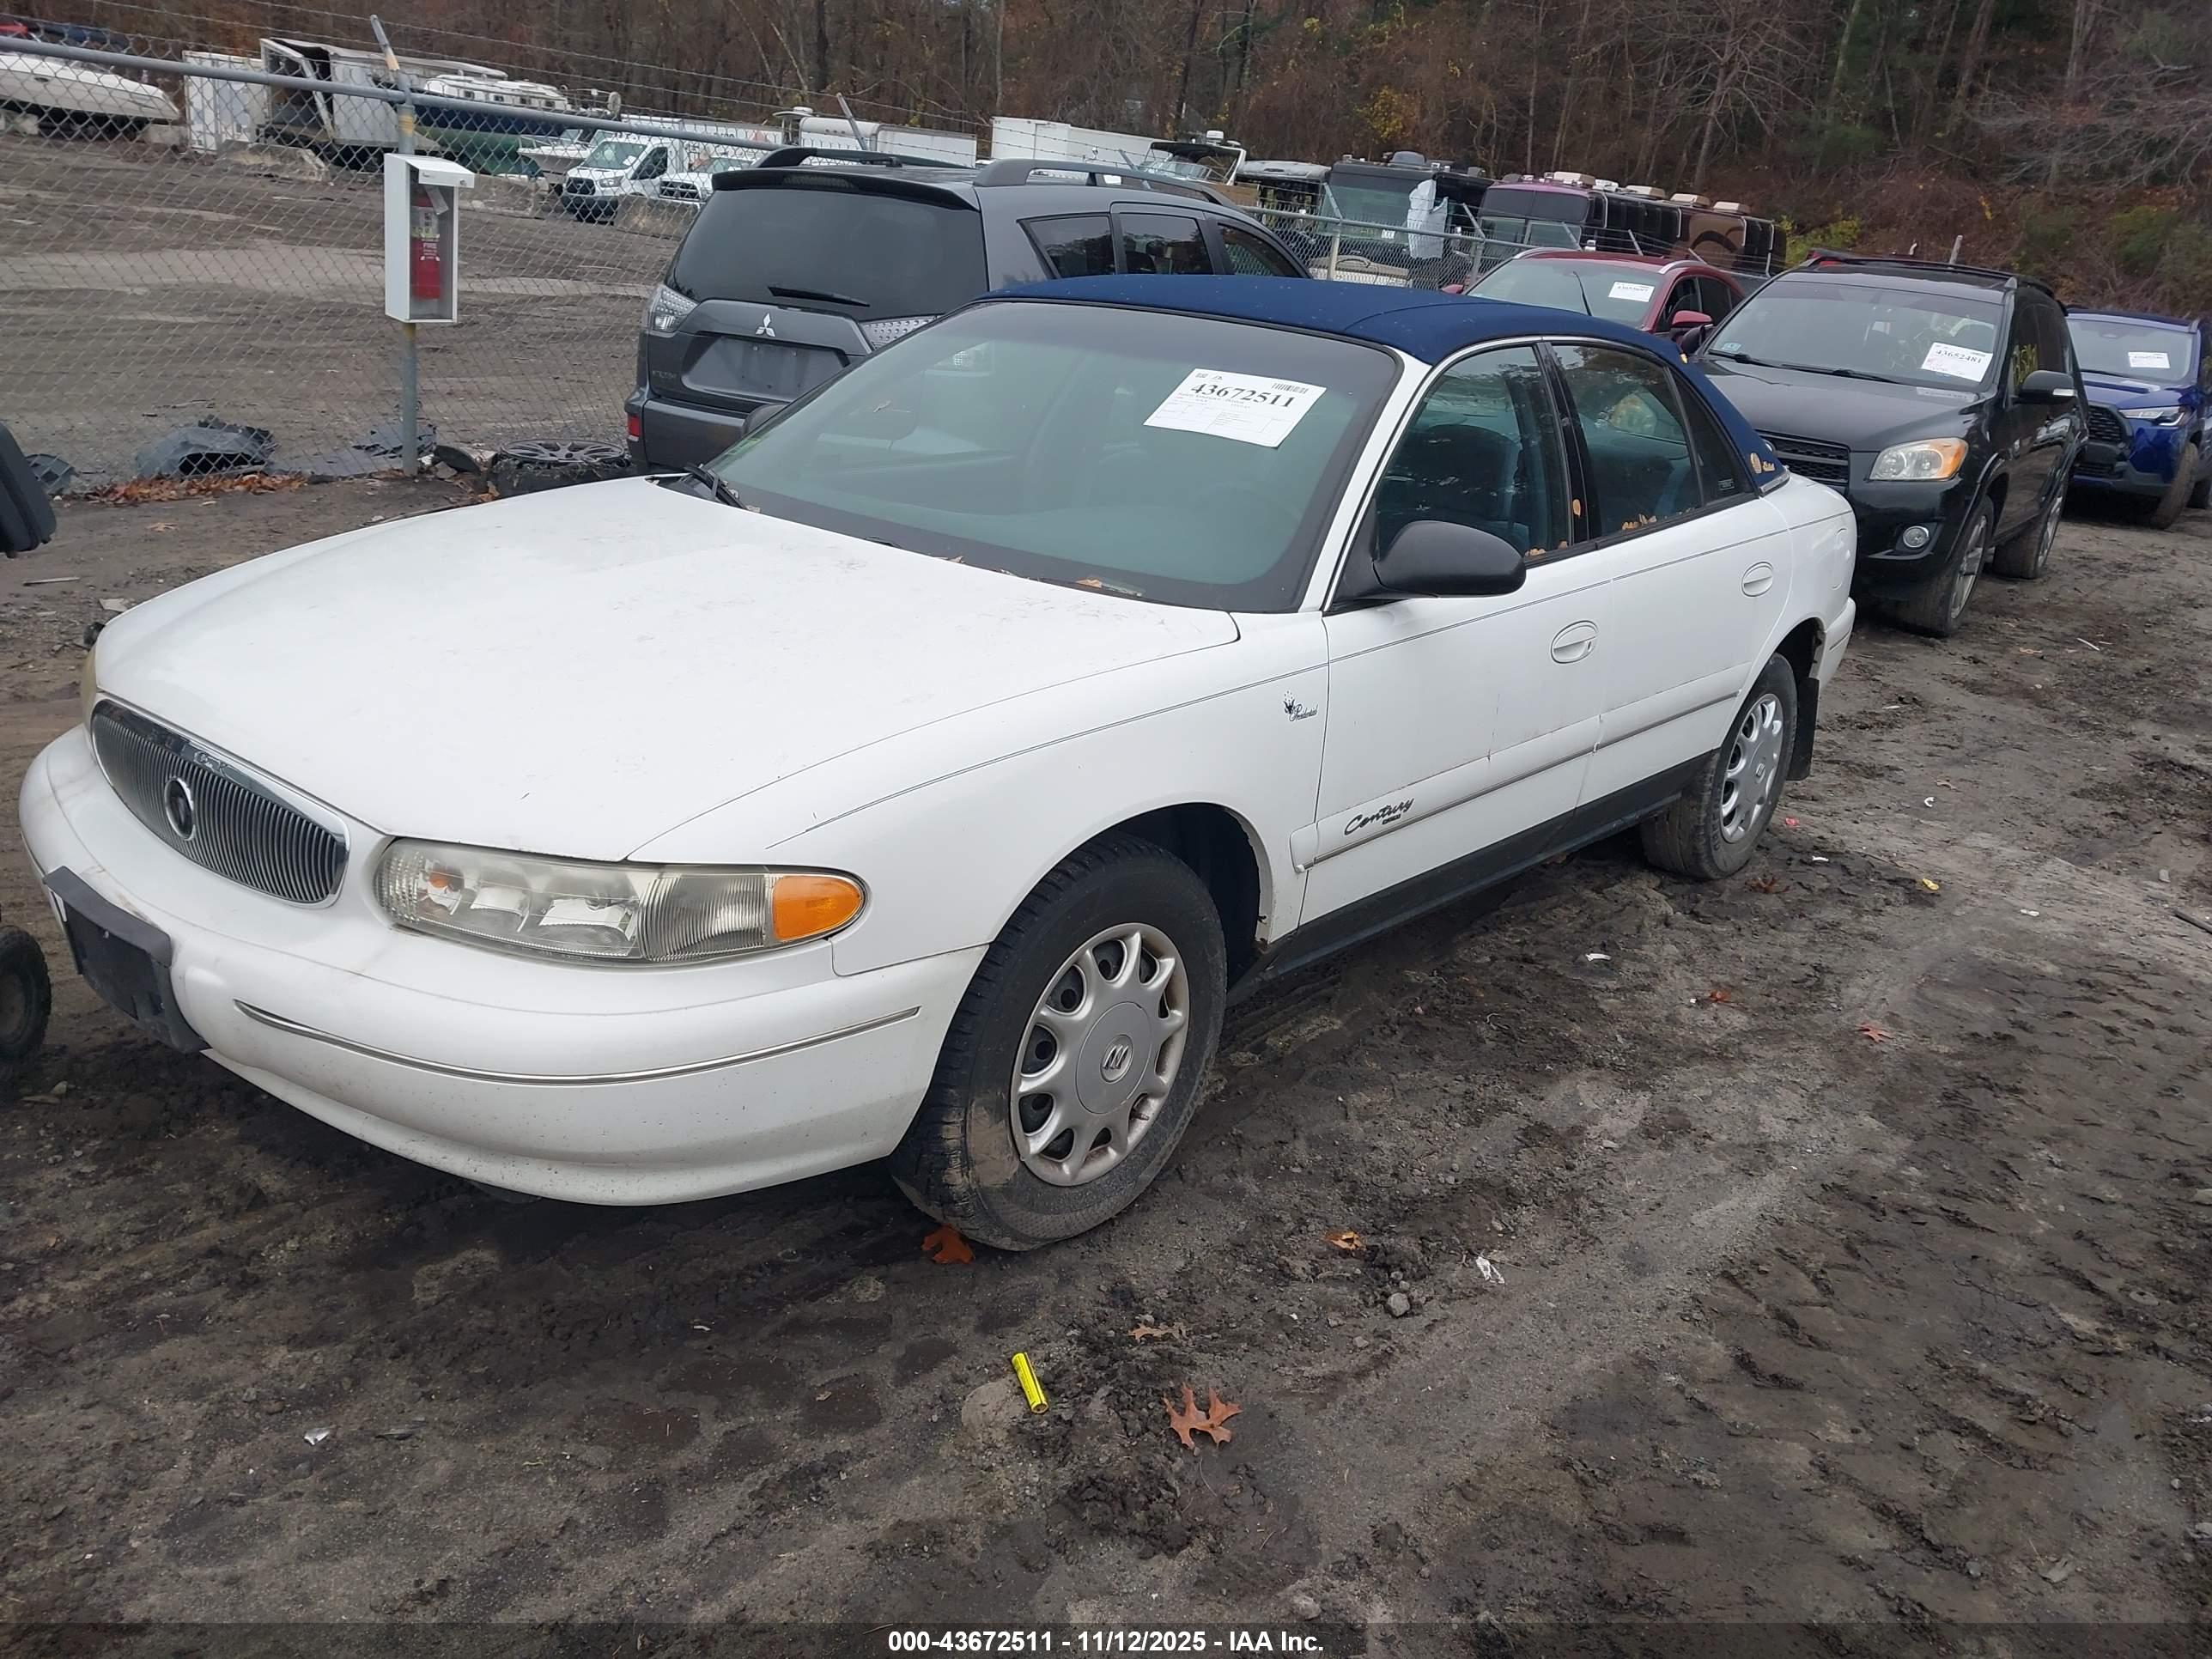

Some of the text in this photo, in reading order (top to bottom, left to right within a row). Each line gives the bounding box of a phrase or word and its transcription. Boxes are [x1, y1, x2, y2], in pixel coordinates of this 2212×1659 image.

[1936, 349, 1982, 363] 43652481
[1191, 383, 1295, 407] 43672511
[1344, 799, 1414, 835] Century
